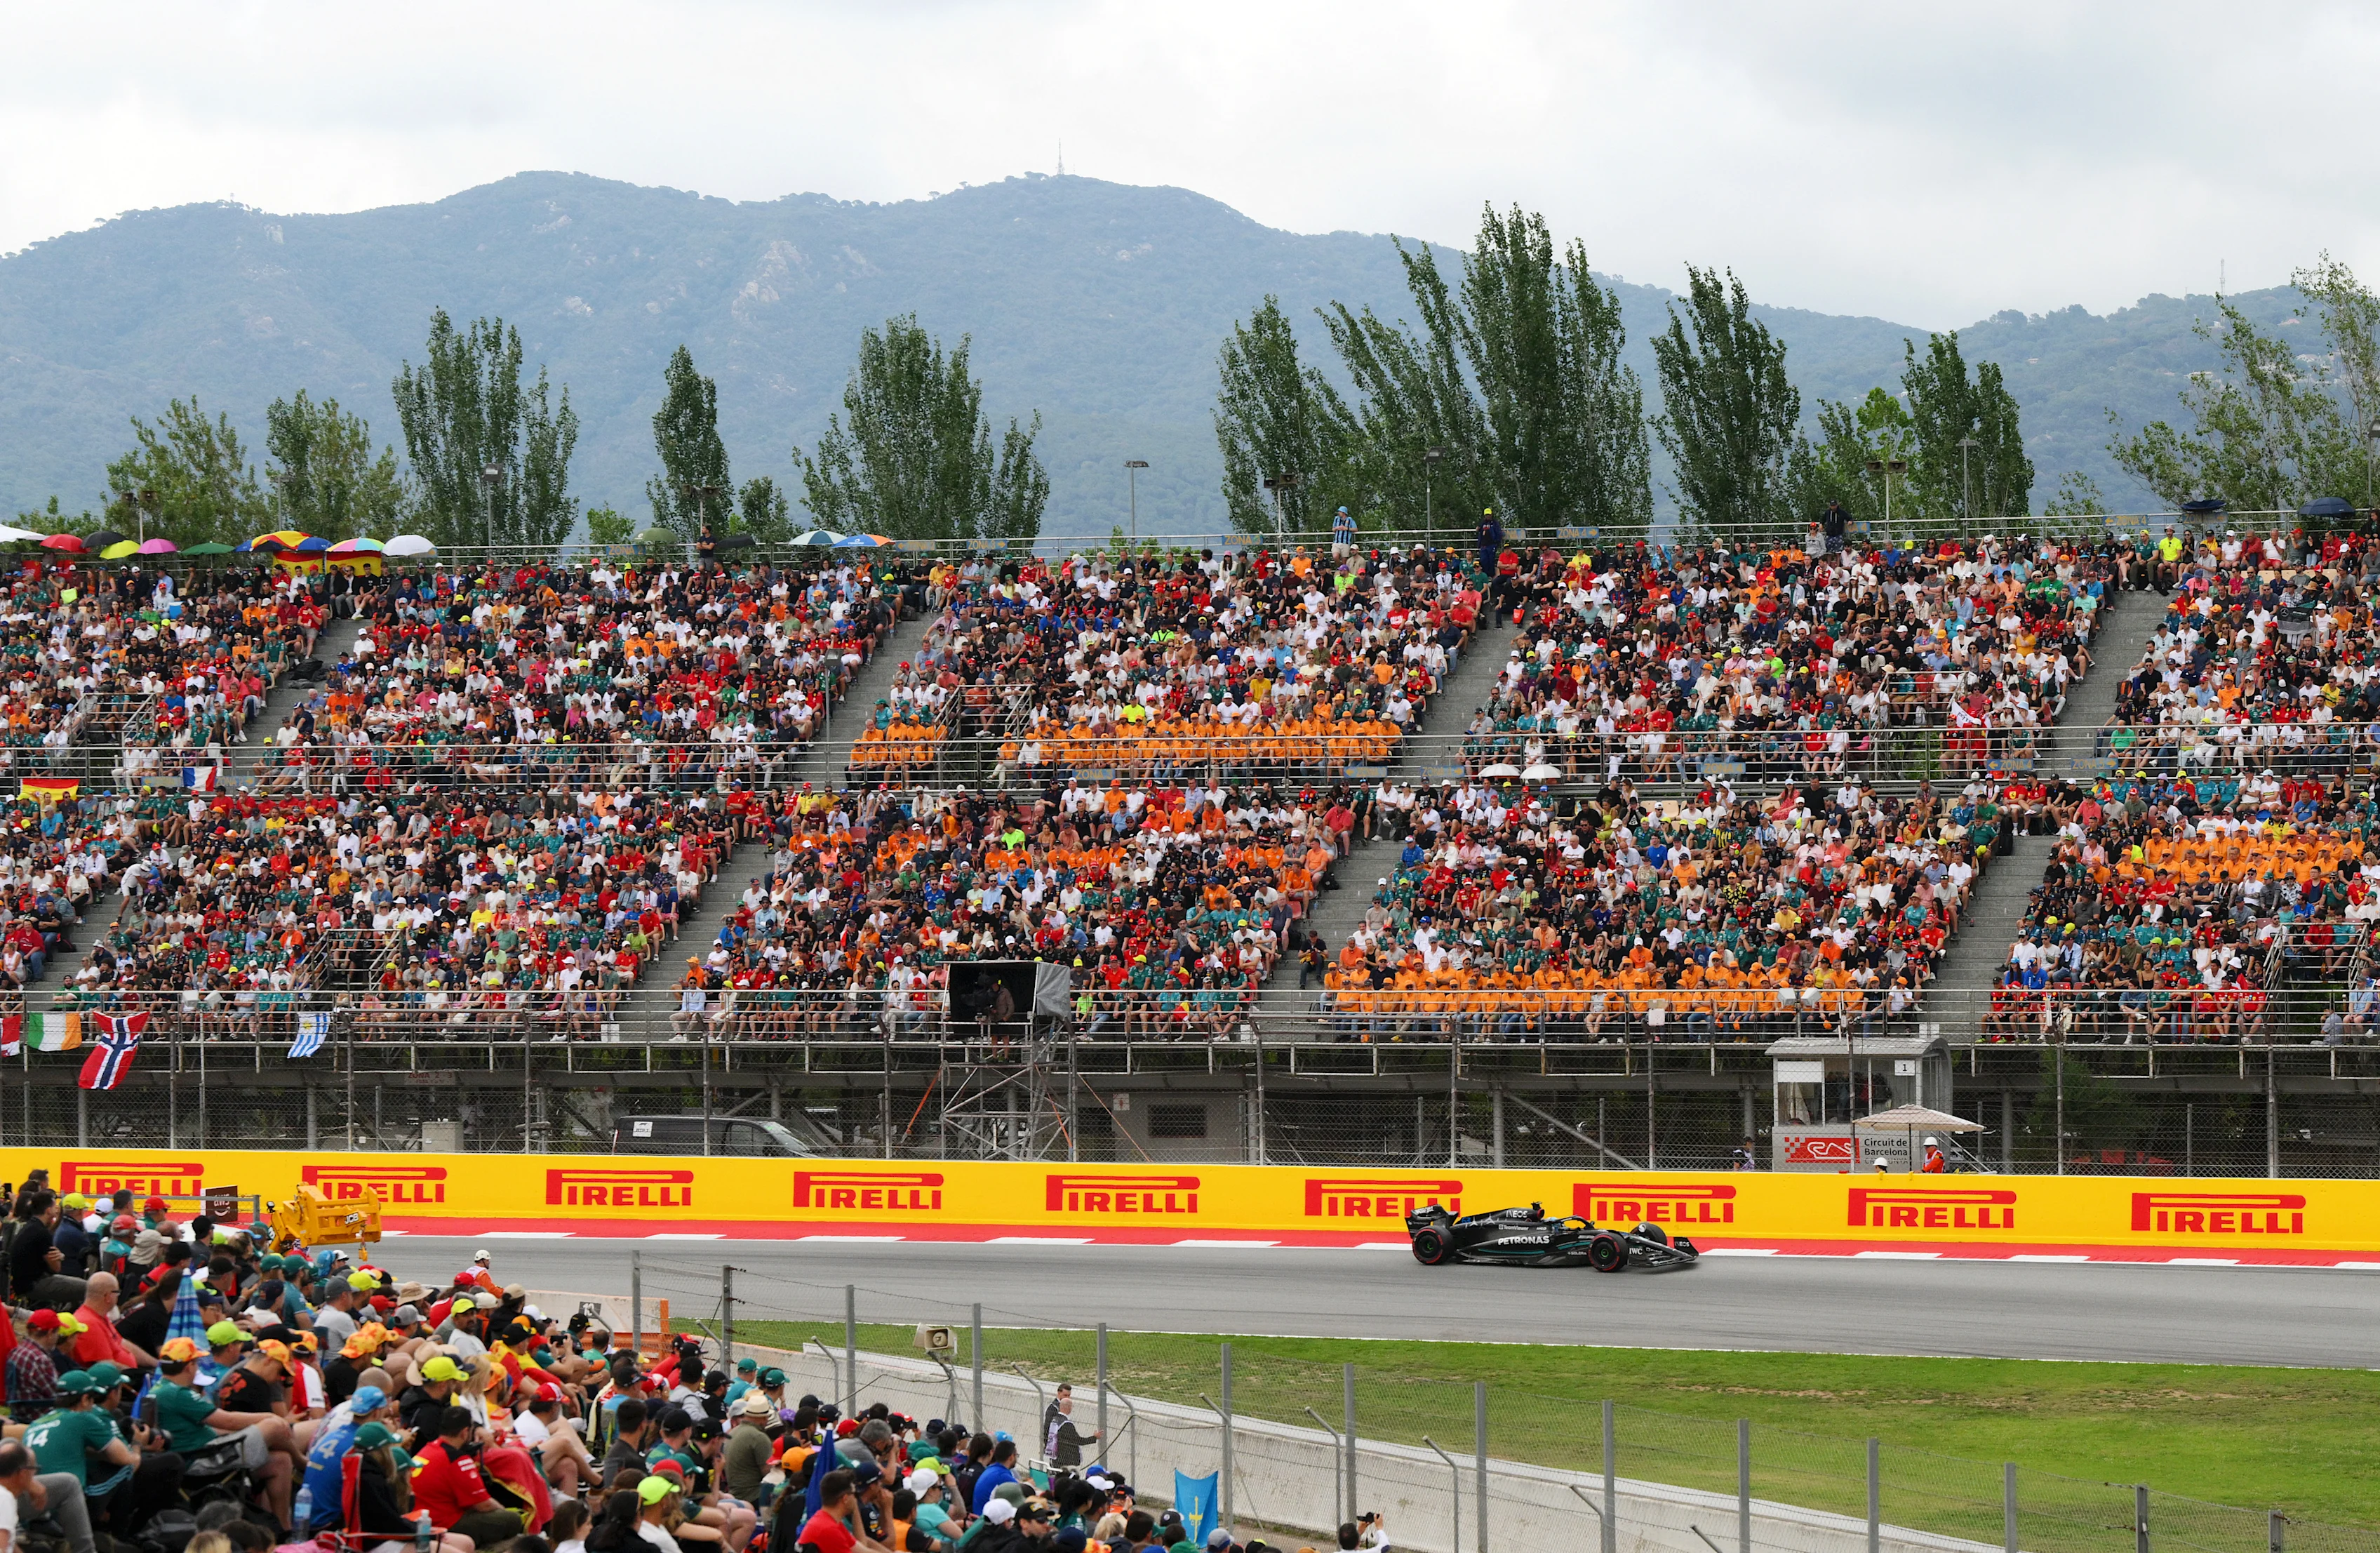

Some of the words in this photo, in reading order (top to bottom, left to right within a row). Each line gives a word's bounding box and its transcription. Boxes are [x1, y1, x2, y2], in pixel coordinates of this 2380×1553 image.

[2115, 516, 2139, 526] ZONA
[1558, 528, 1579, 538] ZONA
[968, 540, 989, 550] ZONA
[1224, 535, 1252, 545] ZONA
[608, 545, 635, 555] ZONA
[1704, 764, 1732, 773] ZONA
[2000, 760, 2024, 771] ZONA
[2072, 759, 2097, 769] ZONA
[1076, 769, 1104, 779] ZONA
[1902, 1063, 1908, 1072] 1
[1864, 1138, 1894, 1147] Circuit
[1896, 1138, 1908, 1147] de
[1864, 1147, 1908, 1156] Barcelona
[60, 1162, 204, 1197] PIRELLI
[547, 1170, 694, 1206] PIRELLI
[794, 1172, 944, 1210] PIRELLI
[1047, 1175, 1201, 1213] PIRELLI
[1573, 1184, 1737, 1223] PIRELLI
[1848, 1189, 2017, 1228] PIRELLI
[1506, 1210, 1528, 1218] INEOS
[2132, 1193, 2306, 1234] PIRELLI
[345, 1213, 359, 1225] JCB
[1497, 1235, 1551, 1246] PETRONAS
[26, 1429, 50, 1447] 14
